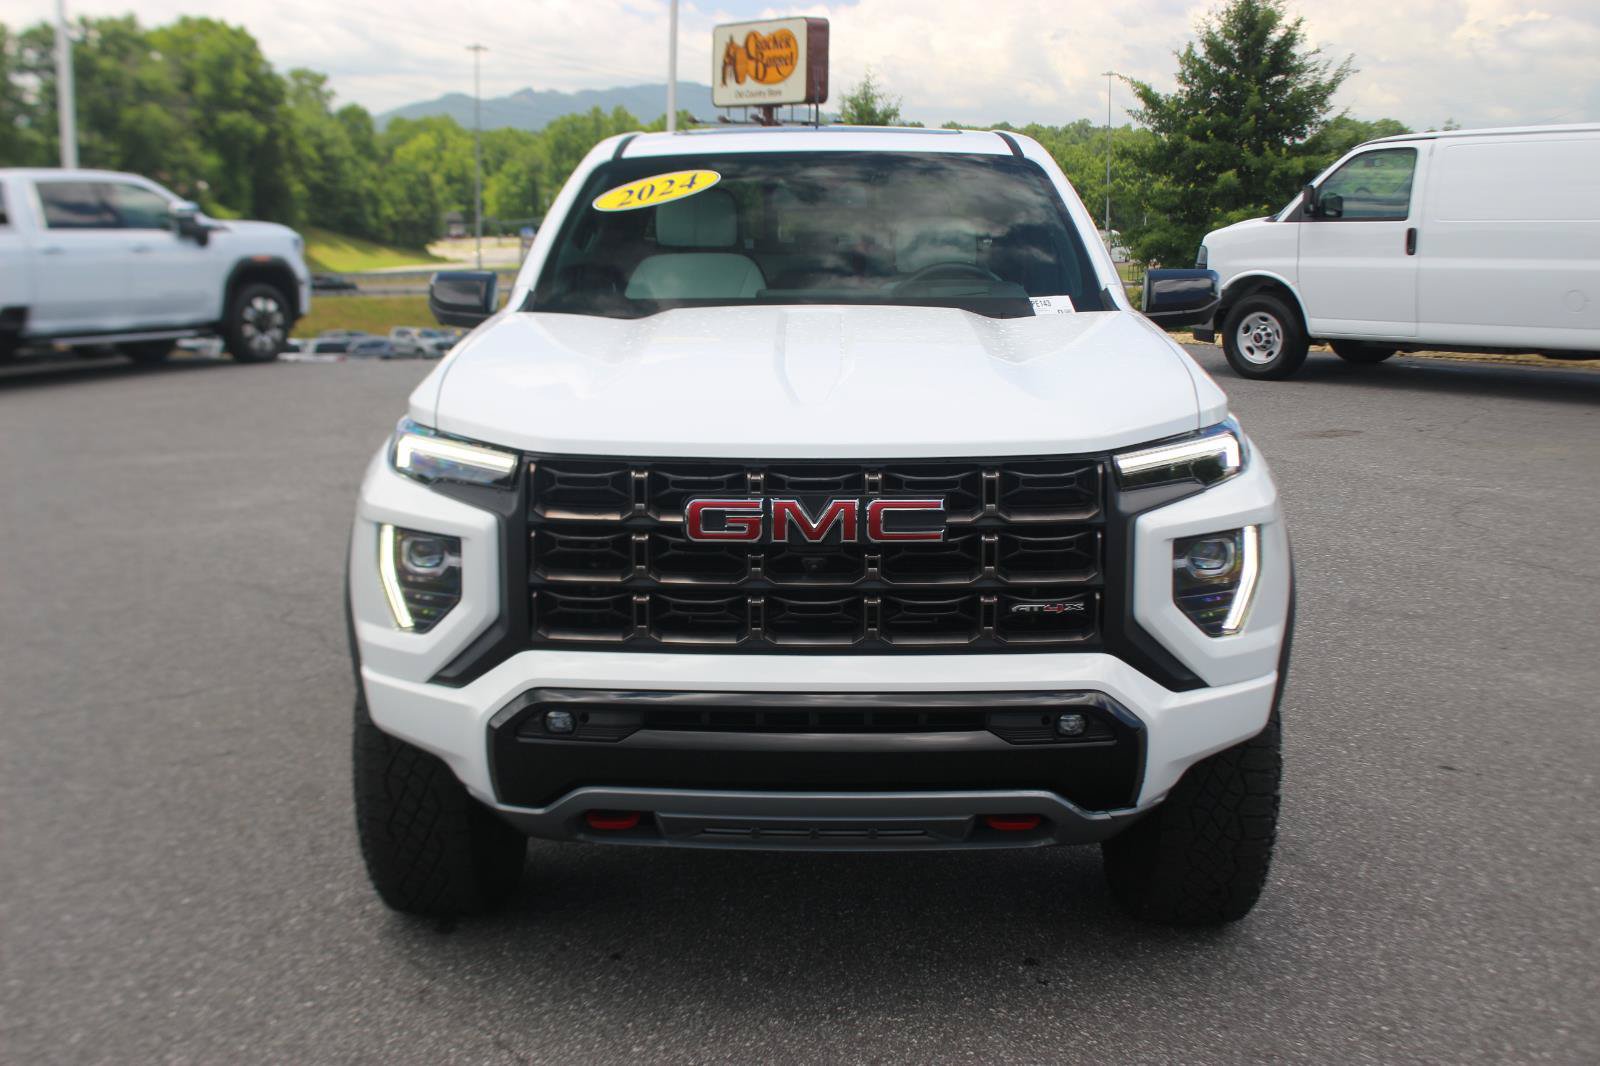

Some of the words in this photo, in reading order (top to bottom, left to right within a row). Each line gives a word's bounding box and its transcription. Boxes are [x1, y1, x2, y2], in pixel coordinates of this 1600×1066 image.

[745, 31, 792, 60] Cracker
[755, 51, 794, 81] Barrel
[617, 172, 698, 207] 2024
[684, 498, 945, 543] GMC
[1011, 602, 1085, 614] AT4X
